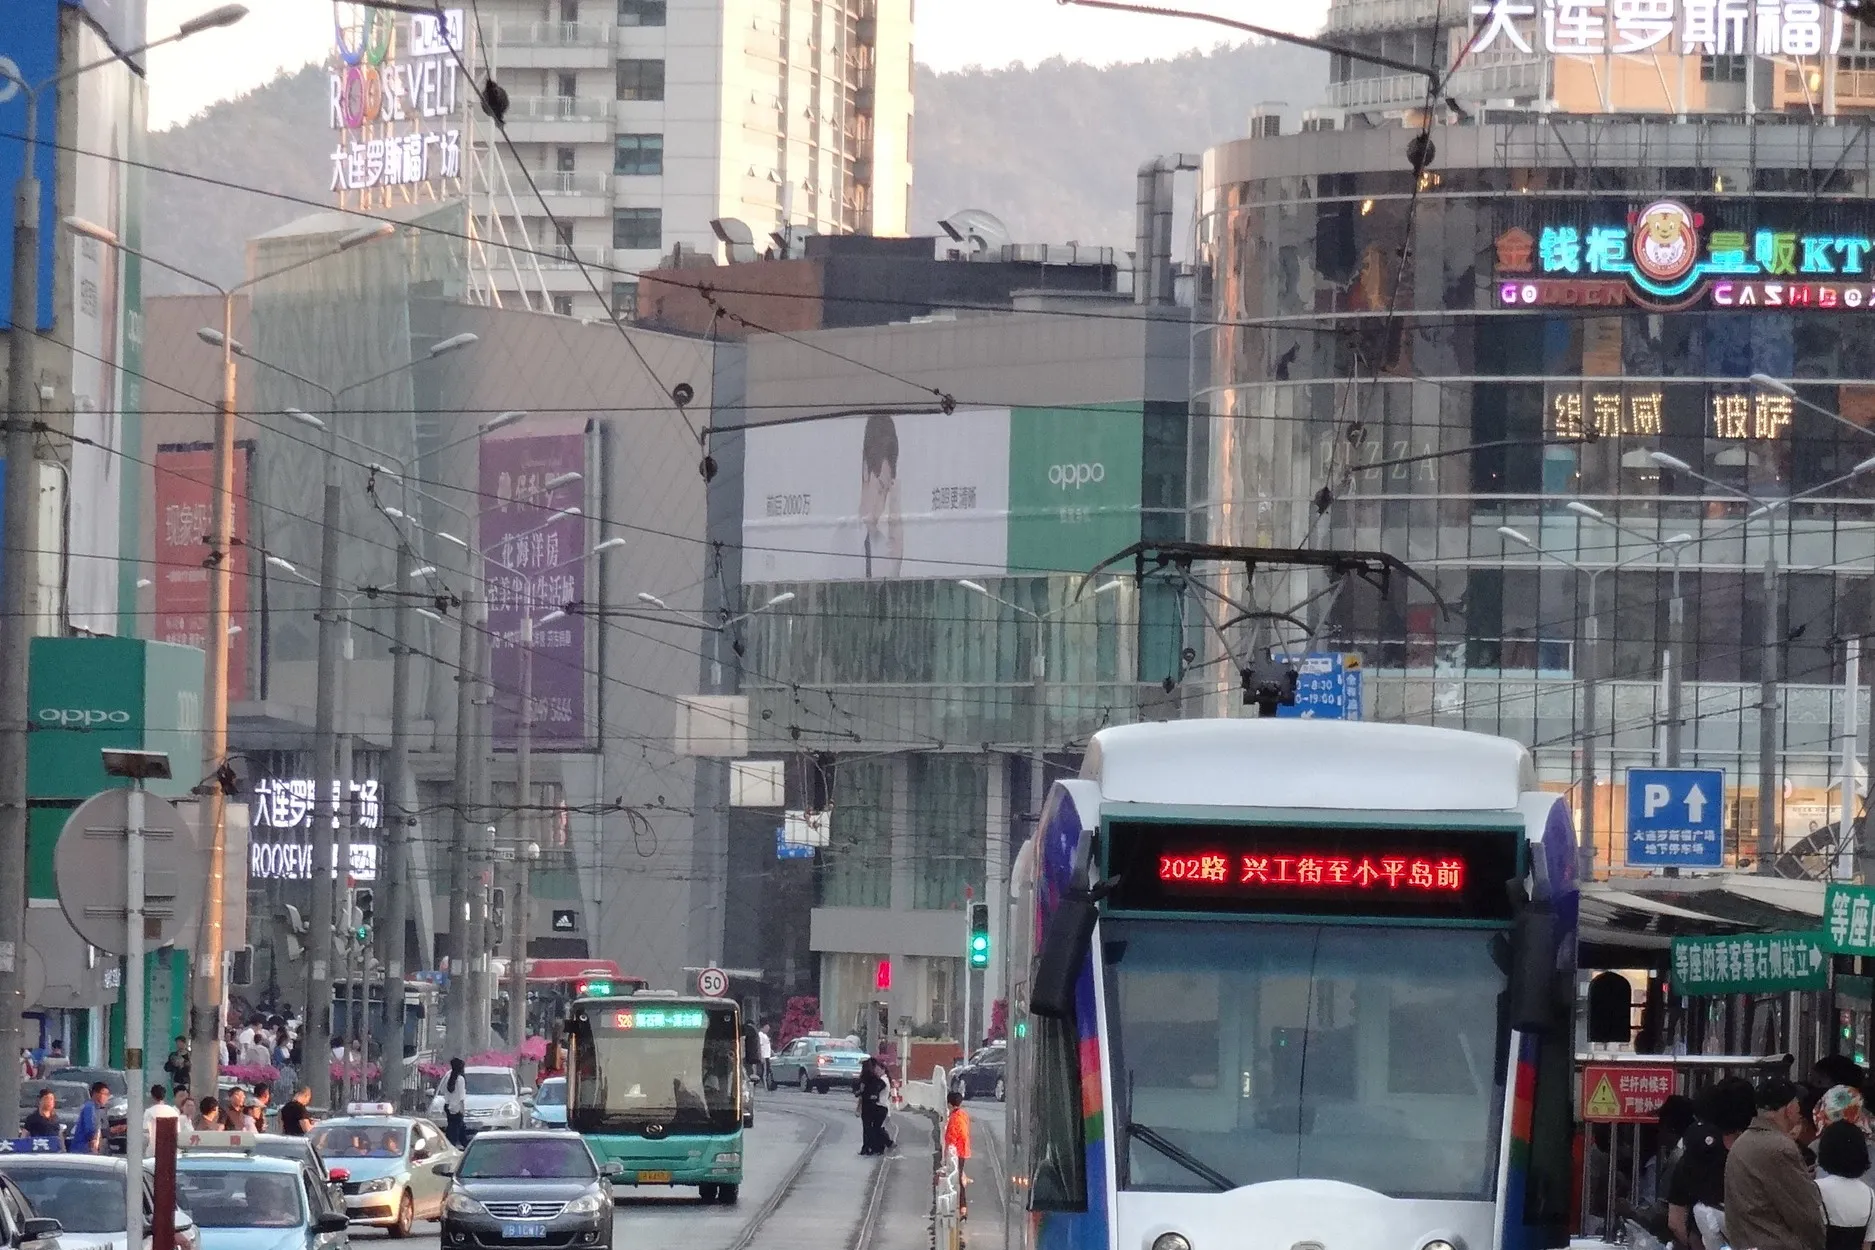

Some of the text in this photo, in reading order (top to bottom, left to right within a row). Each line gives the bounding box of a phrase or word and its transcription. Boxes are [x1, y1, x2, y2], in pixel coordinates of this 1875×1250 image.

[330, 60, 459, 129] ROOSEVELT
[330, 130, 460, 190] 大连罗斯福广场
[1707, 229, 1875, 275] 量贩KT
[1713, 392, 1792, 439] 披萨
[1048, 461, 1104, 490] oppo
[1320, 440, 1435, 481] PIZZA
[39, 708, 130, 725] oppo
[1644, 784, 1670, 818] P
[1160, 856, 1463, 888] 202路 兴工街至小平岛前
[1830, 891, 1875, 947] 等座
[1676, 939, 1809, 983] 等座的乘客靠右侧站立
[704, 976, 721, 989] 50
